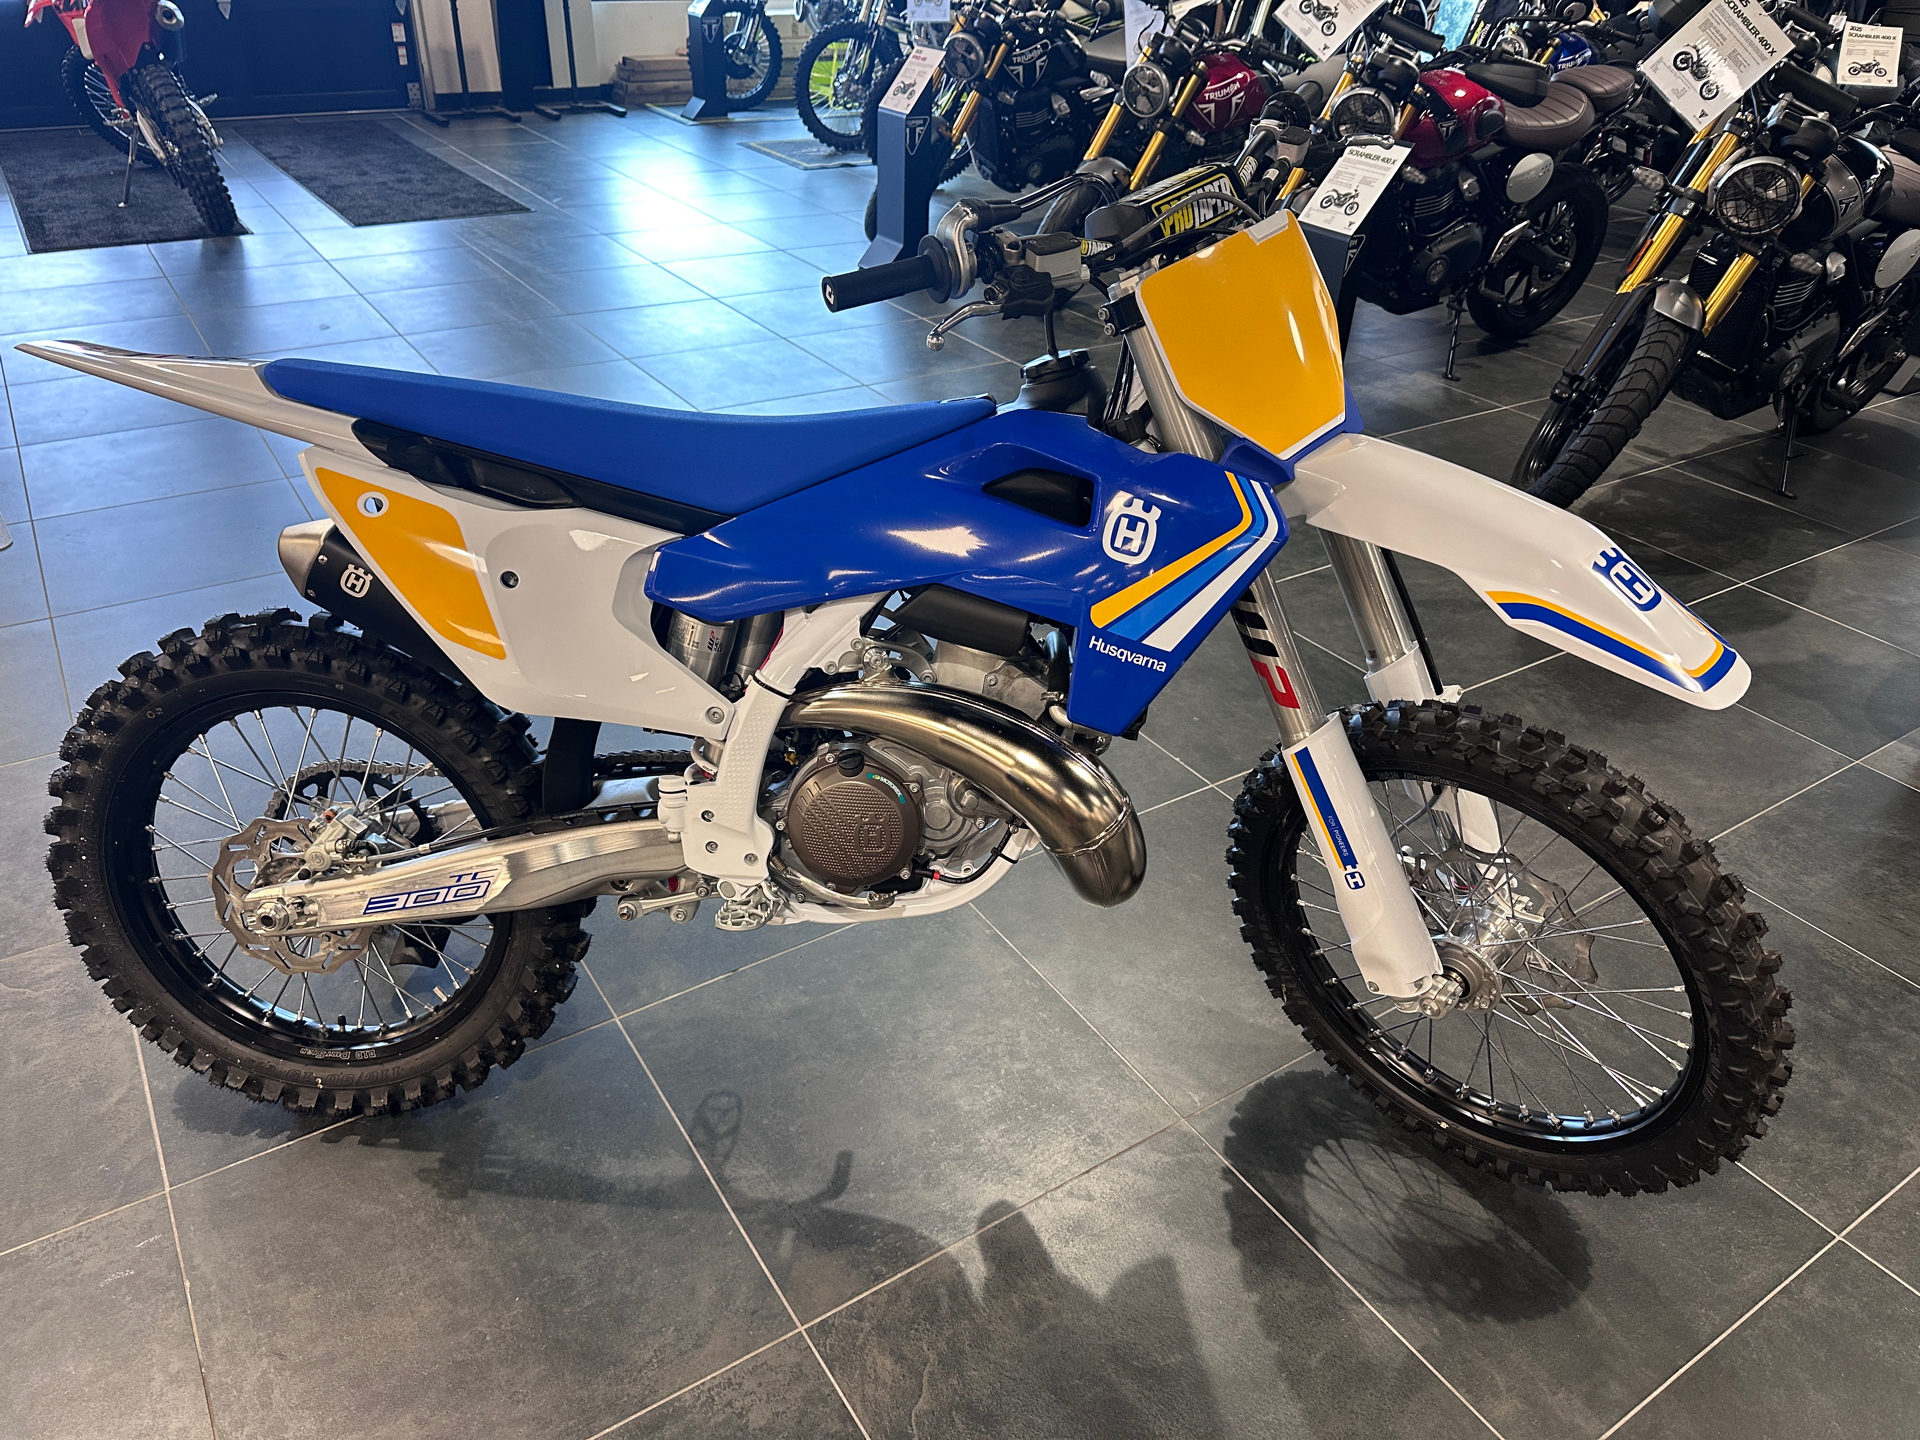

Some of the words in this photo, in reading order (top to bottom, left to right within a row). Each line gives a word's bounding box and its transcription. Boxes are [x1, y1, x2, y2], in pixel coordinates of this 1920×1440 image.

[1724, 0, 1760, 39] SCRAMBLER
[1757, 36, 1772, 51] 400
[1768, 47, 1777, 57] X
[1847, 32, 1881, 40] SCRAMBLER
[1012, 47, 1043, 64] TRIUMPH
[1204, 81, 1241, 101] TRIUMPH
[1347, 148, 1381, 163] SCRAMBLER
[1379, 156, 1392, 165] 400
[1391, 158, 1398, 166] X
[1088, 635, 1168, 673] Husqvarna
[1327, 815, 1336, 827] FOR
[1333, 829, 1349, 857] PIONEERS
[363, 880, 491, 915] 300
